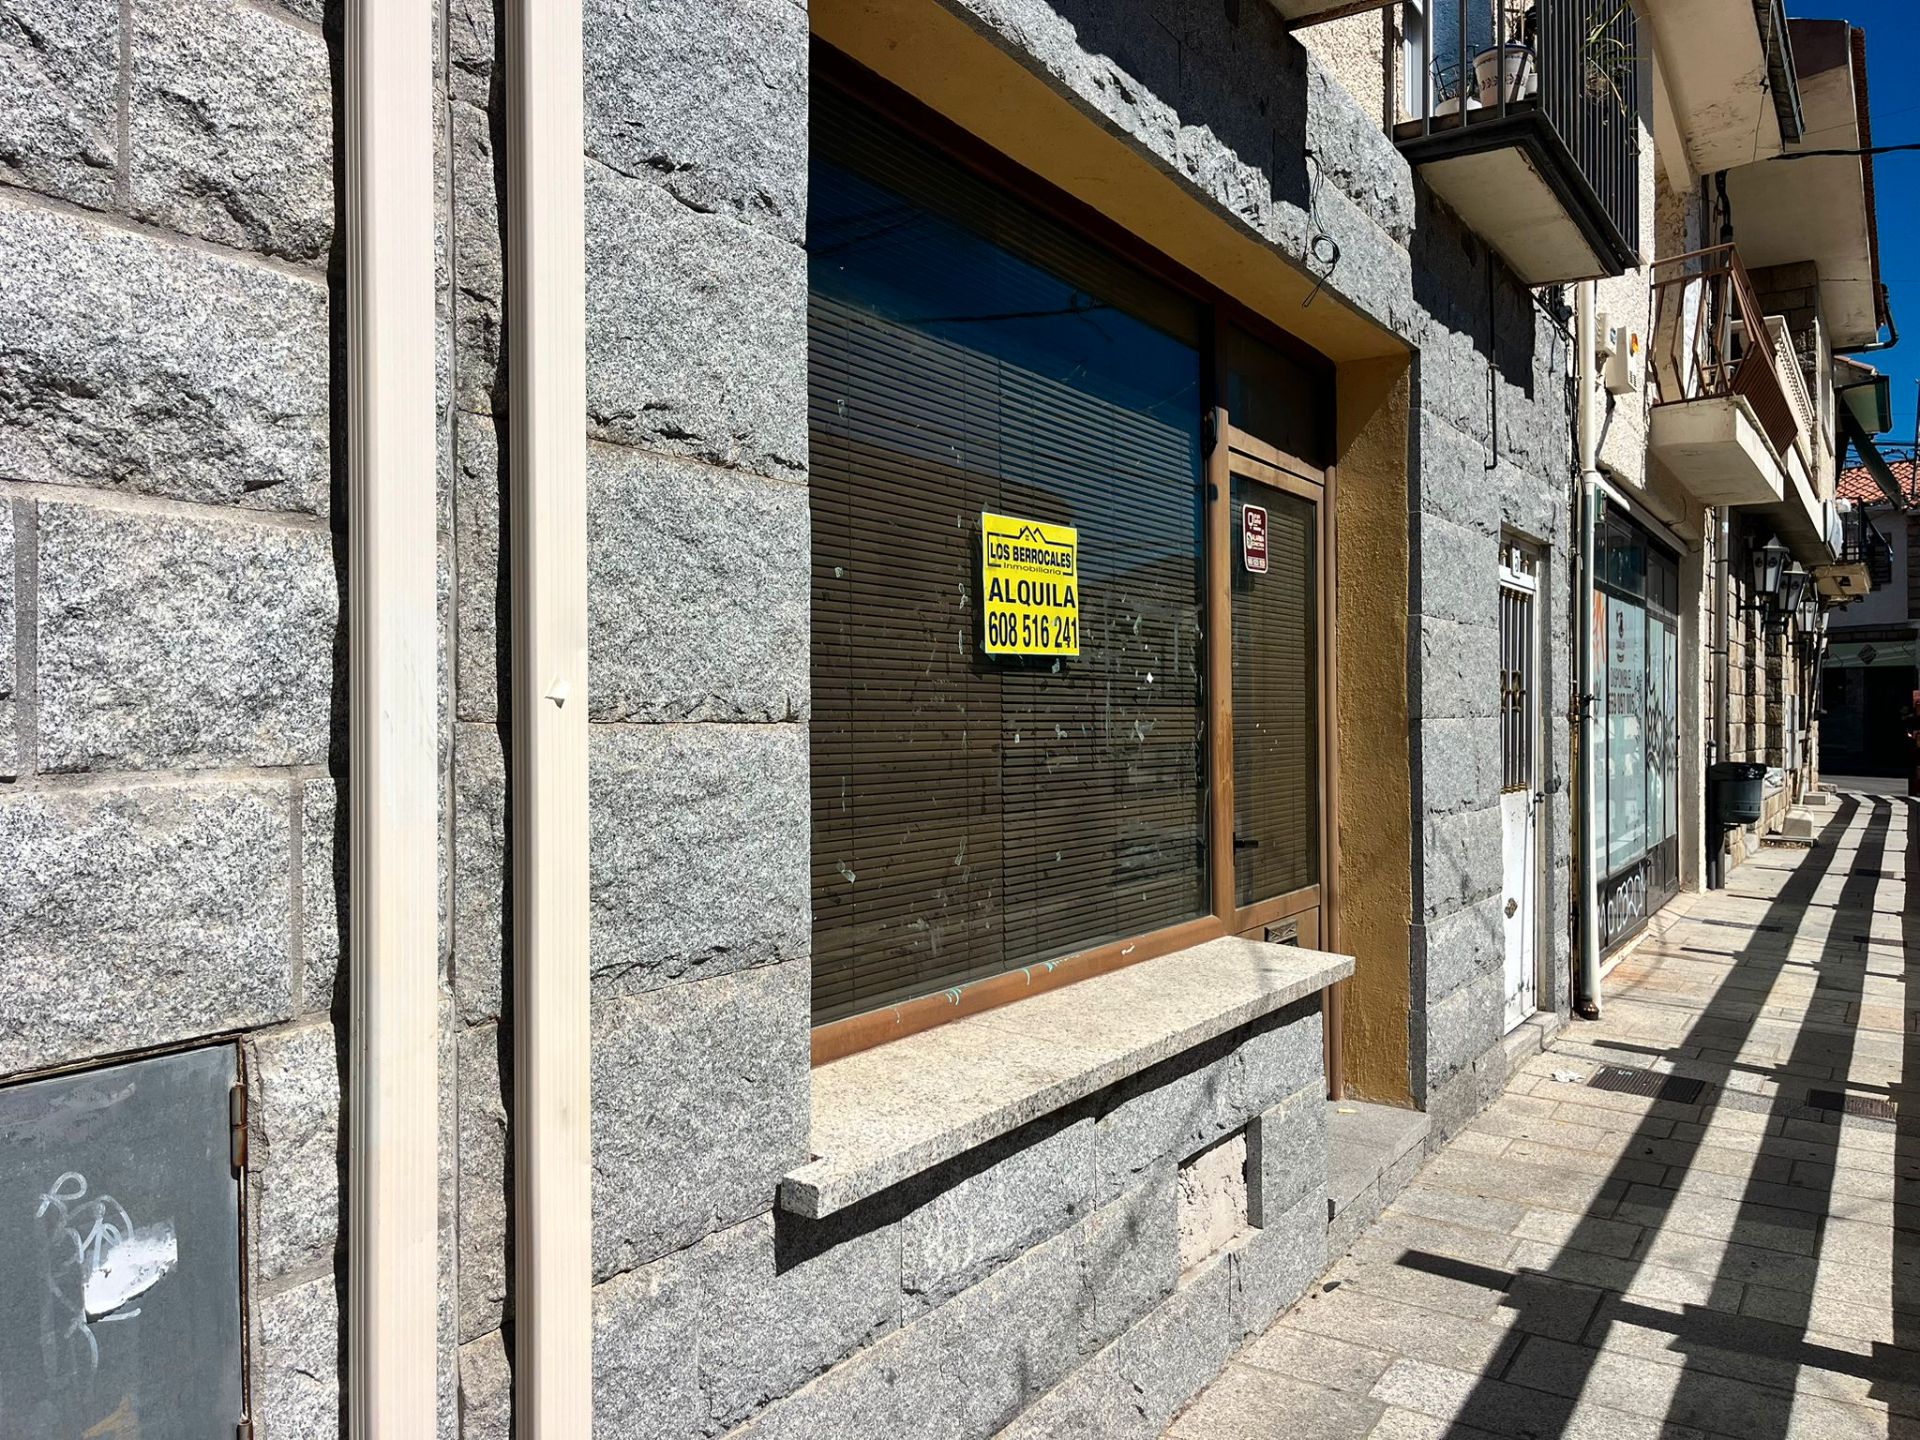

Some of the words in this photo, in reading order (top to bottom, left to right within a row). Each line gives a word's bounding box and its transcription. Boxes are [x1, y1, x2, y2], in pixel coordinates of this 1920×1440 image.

[990, 542, 1009, 560] LOS
[1013, 546, 1071, 568] BERROCALES
[1003, 562, 1062, 575] Inmobiliaria
[989, 578, 1076, 608] ALQUILA
[988, 611, 1018, 647] 608
[1022, 614, 1050, 648] 516
[1054, 616, 1078, 649] 241
